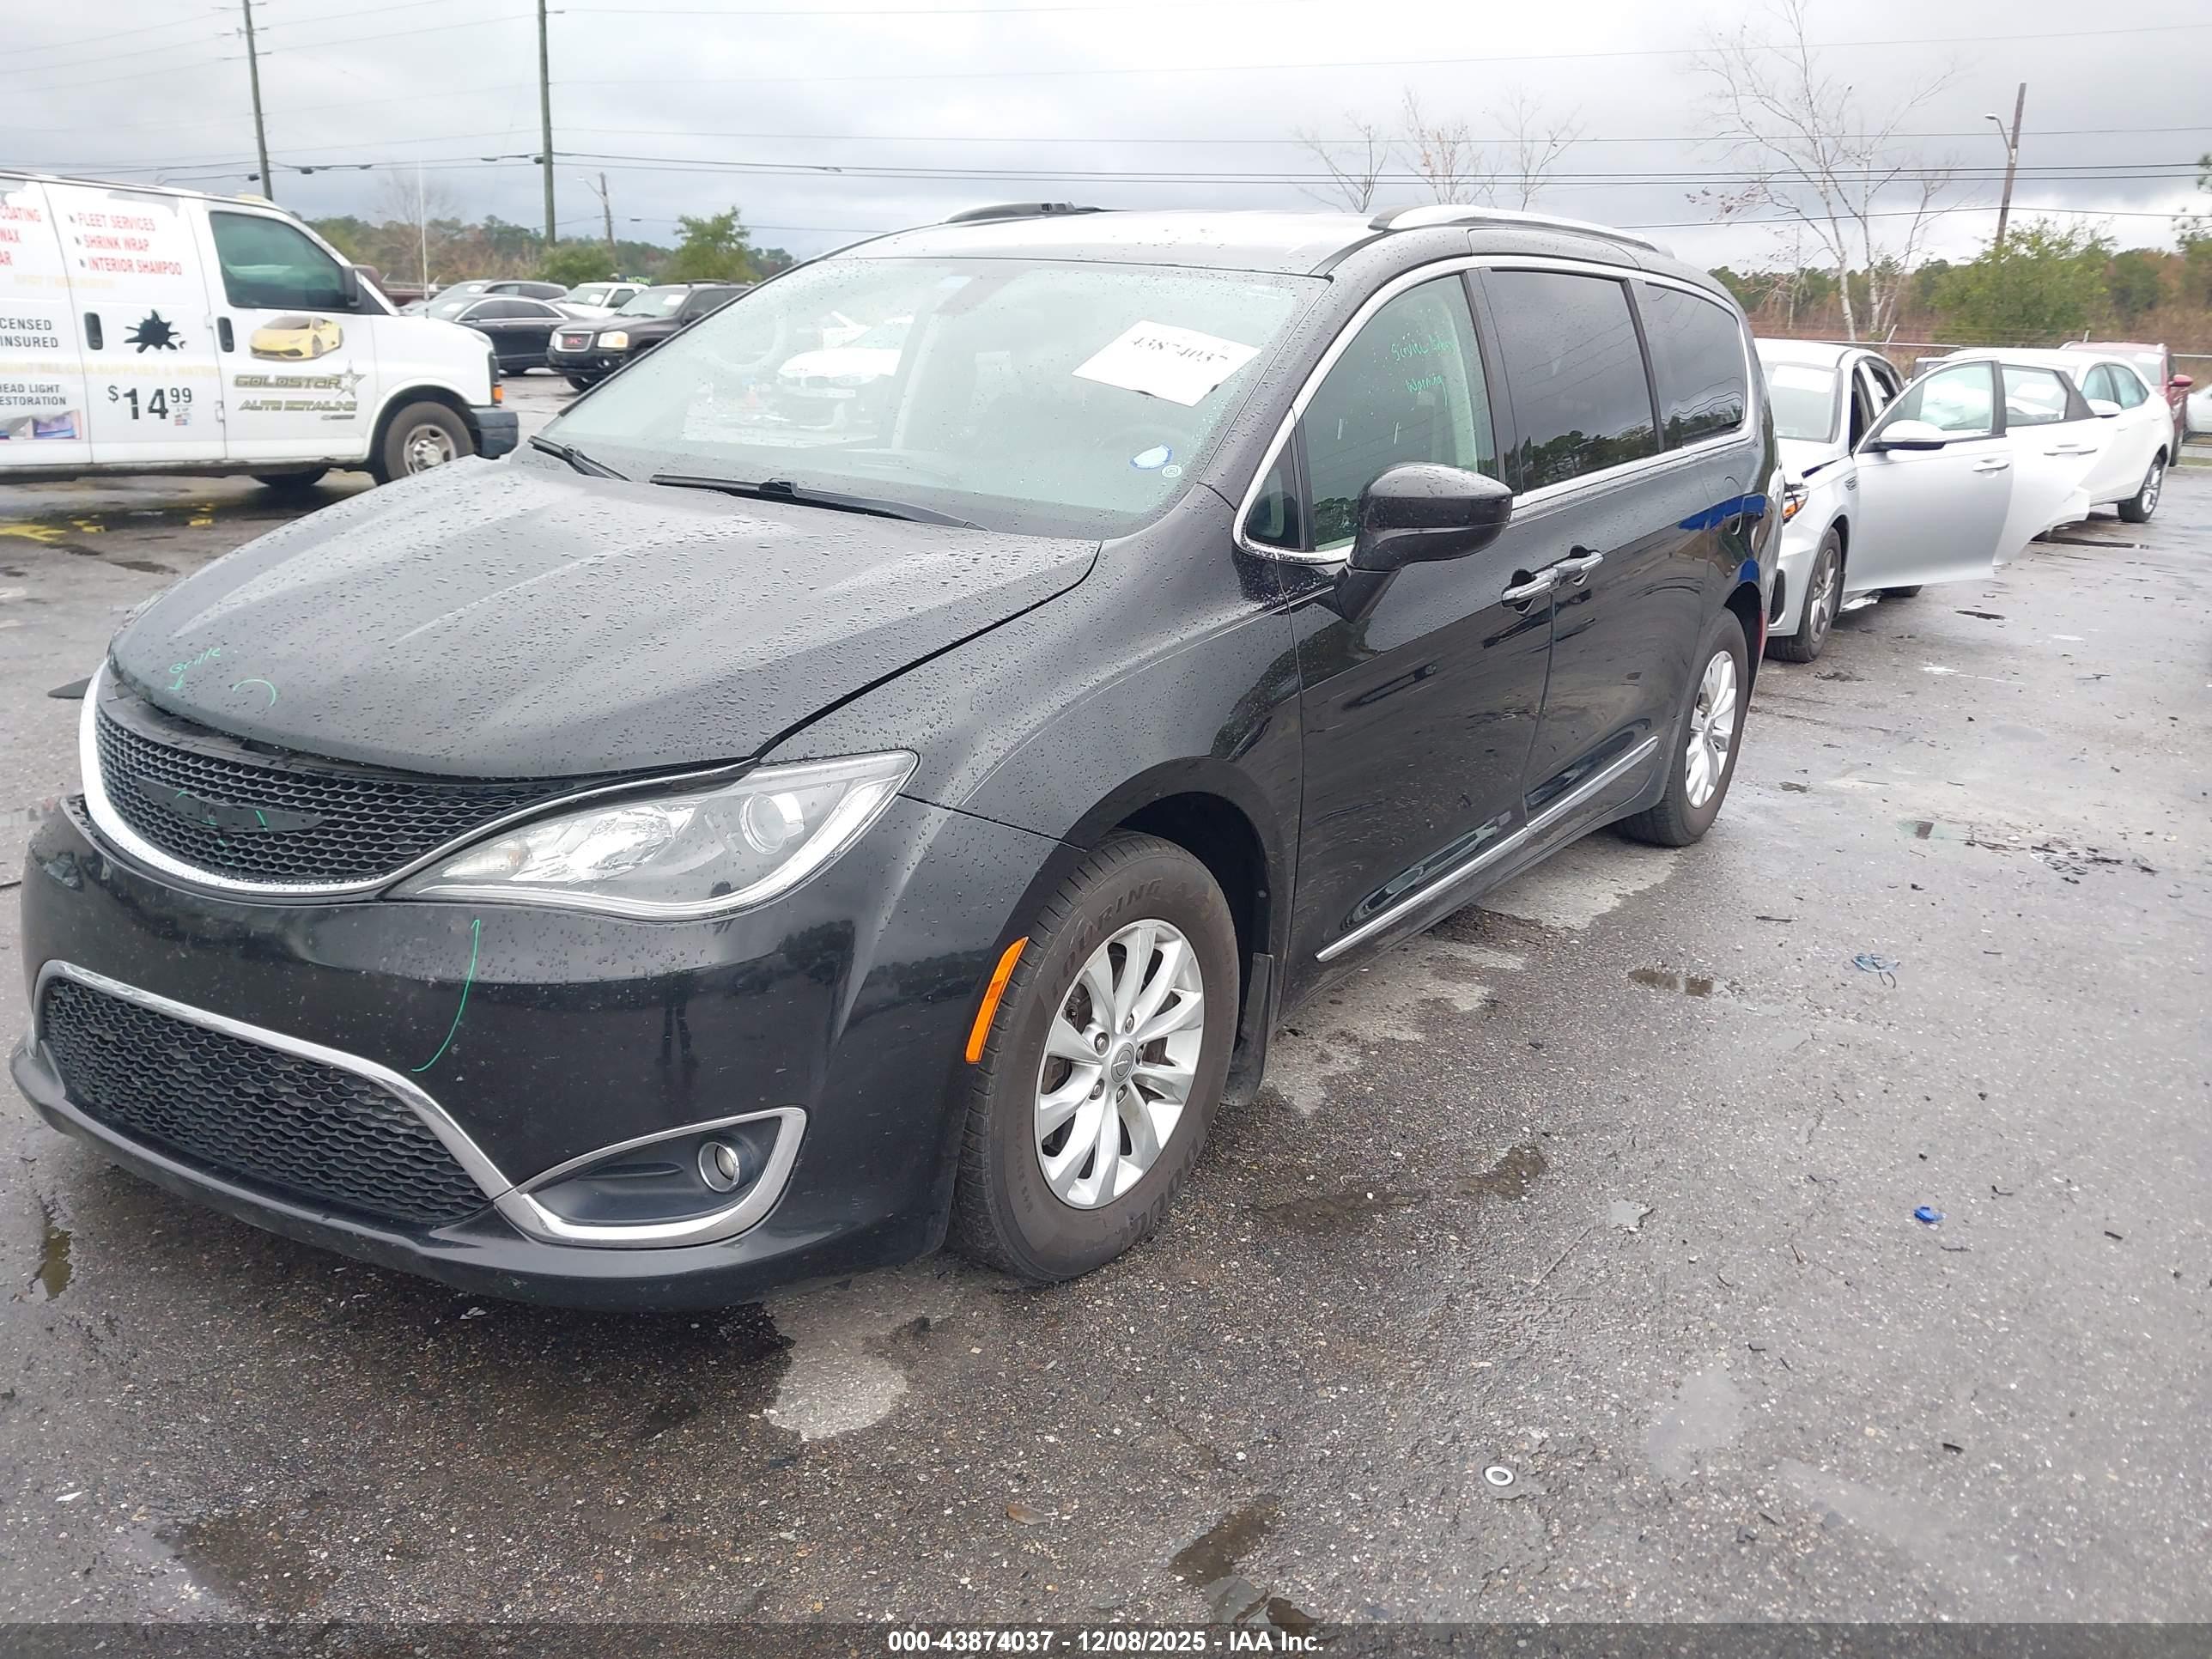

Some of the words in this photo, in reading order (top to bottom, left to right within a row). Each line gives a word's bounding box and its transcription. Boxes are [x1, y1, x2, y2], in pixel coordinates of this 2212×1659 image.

[78, 212, 106, 228] FLEET
[110, 215, 155, 231] SERVICES
[83, 234, 120, 250] SHRINK
[123, 237, 149, 252] WRAP
[88, 257, 134, 273] INTERIOR
[137, 259, 182, 276] SHAMPOO
[0, 336, 58, 348] INSURED
[0, 384, 24, 392] EAD
[29, 384, 60, 393] LIGHT
